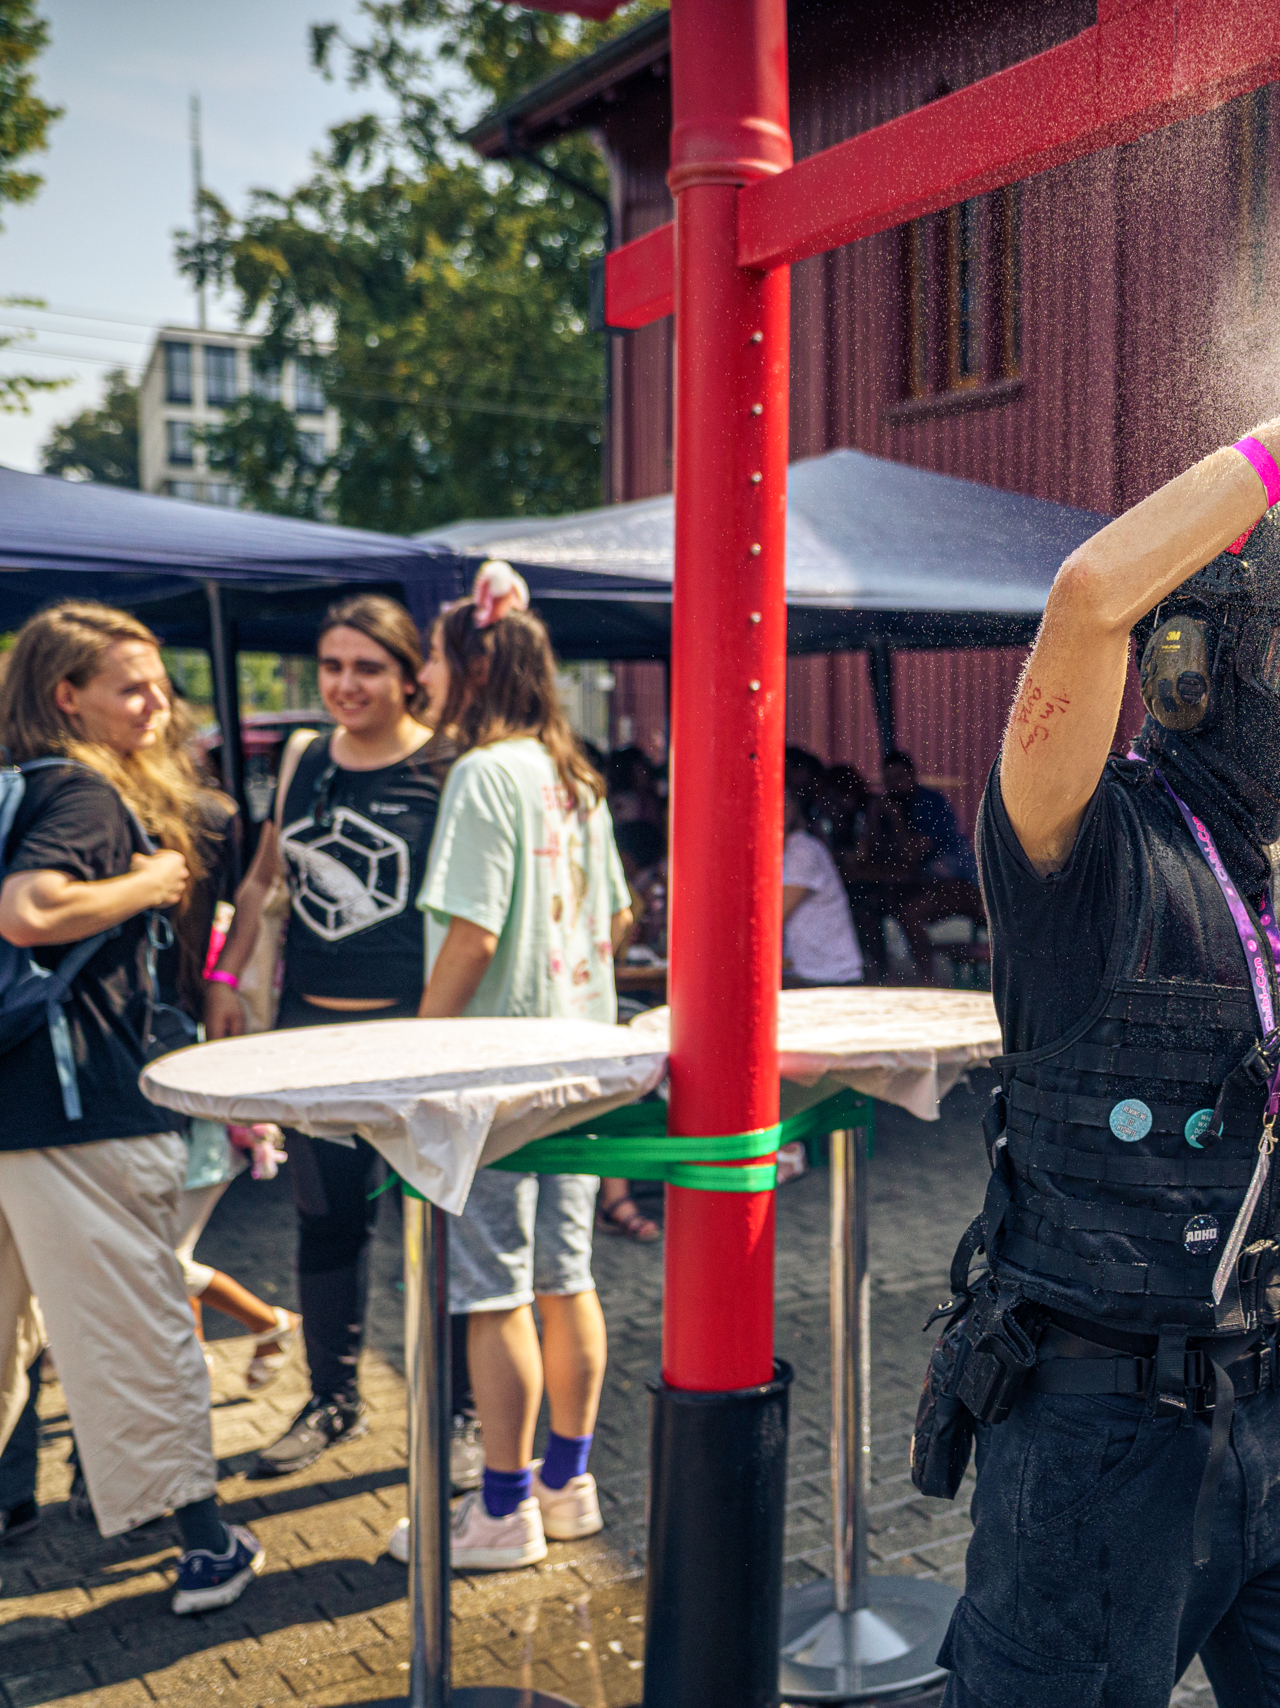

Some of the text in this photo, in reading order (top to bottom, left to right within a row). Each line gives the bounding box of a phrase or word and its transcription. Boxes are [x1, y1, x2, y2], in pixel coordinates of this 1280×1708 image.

[1166, 630, 1181, 641] 3M
[1192, 815, 1228, 882] Chibi-Con
[1254, 957, 1274, 1032] Chibi-Con
